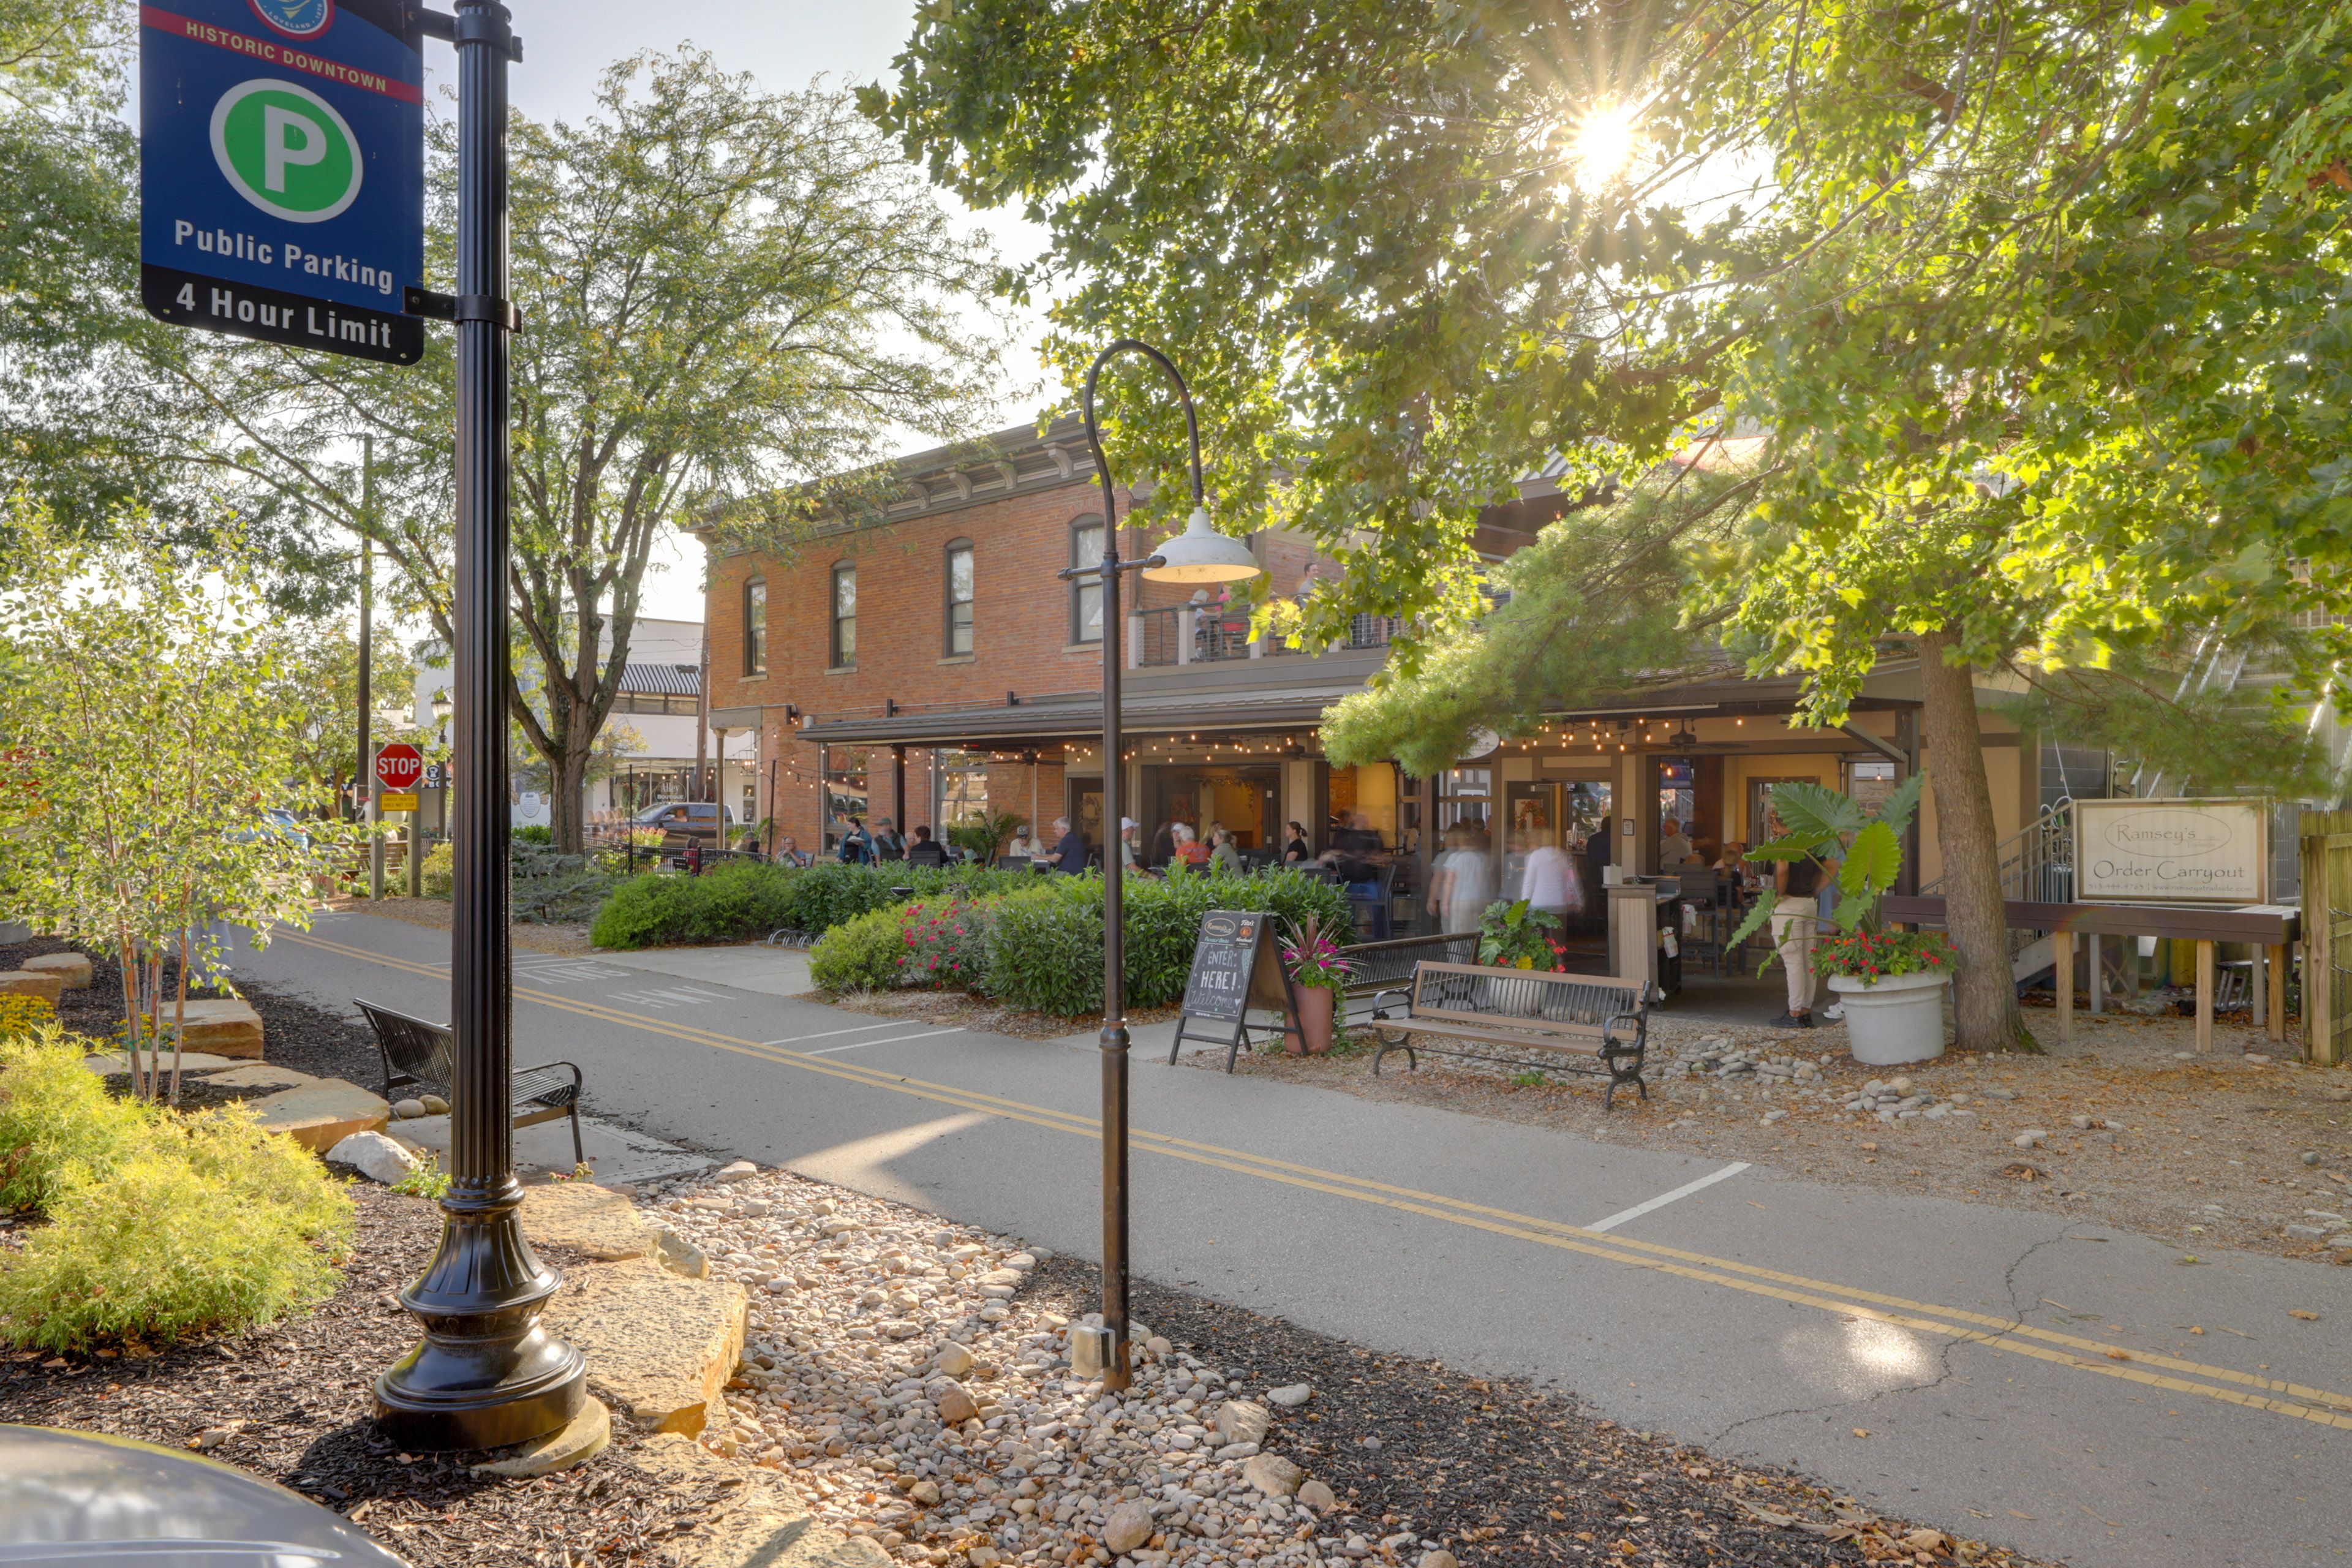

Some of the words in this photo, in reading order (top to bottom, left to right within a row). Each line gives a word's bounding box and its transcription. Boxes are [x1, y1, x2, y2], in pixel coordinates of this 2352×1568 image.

[268, 11, 311, 29] LOVELAND
[186, 21, 276, 59] HISTORIC
[283, 50, 387, 92] DOWNTOWN
[265, 104, 327, 194] P
[175, 219, 273, 264] Public
[285, 244, 393, 295] Parking
[176, 282, 195, 311] 4
[211, 288, 294, 330] Hour
[308, 306, 392, 349] Limit
[378, 757, 420, 775] STOP
[661, 782, 679, 794] Alley
[2117, 824, 2196, 845] Ramsey's
[2094, 860, 2152, 879] Order
[2157, 861, 2246, 884] Carryout
[1208, 950, 1234, 967] ENTER
[1200, 971, 1237, 991] HERE!
[1191, 987, 1234, 1008] Welcome
